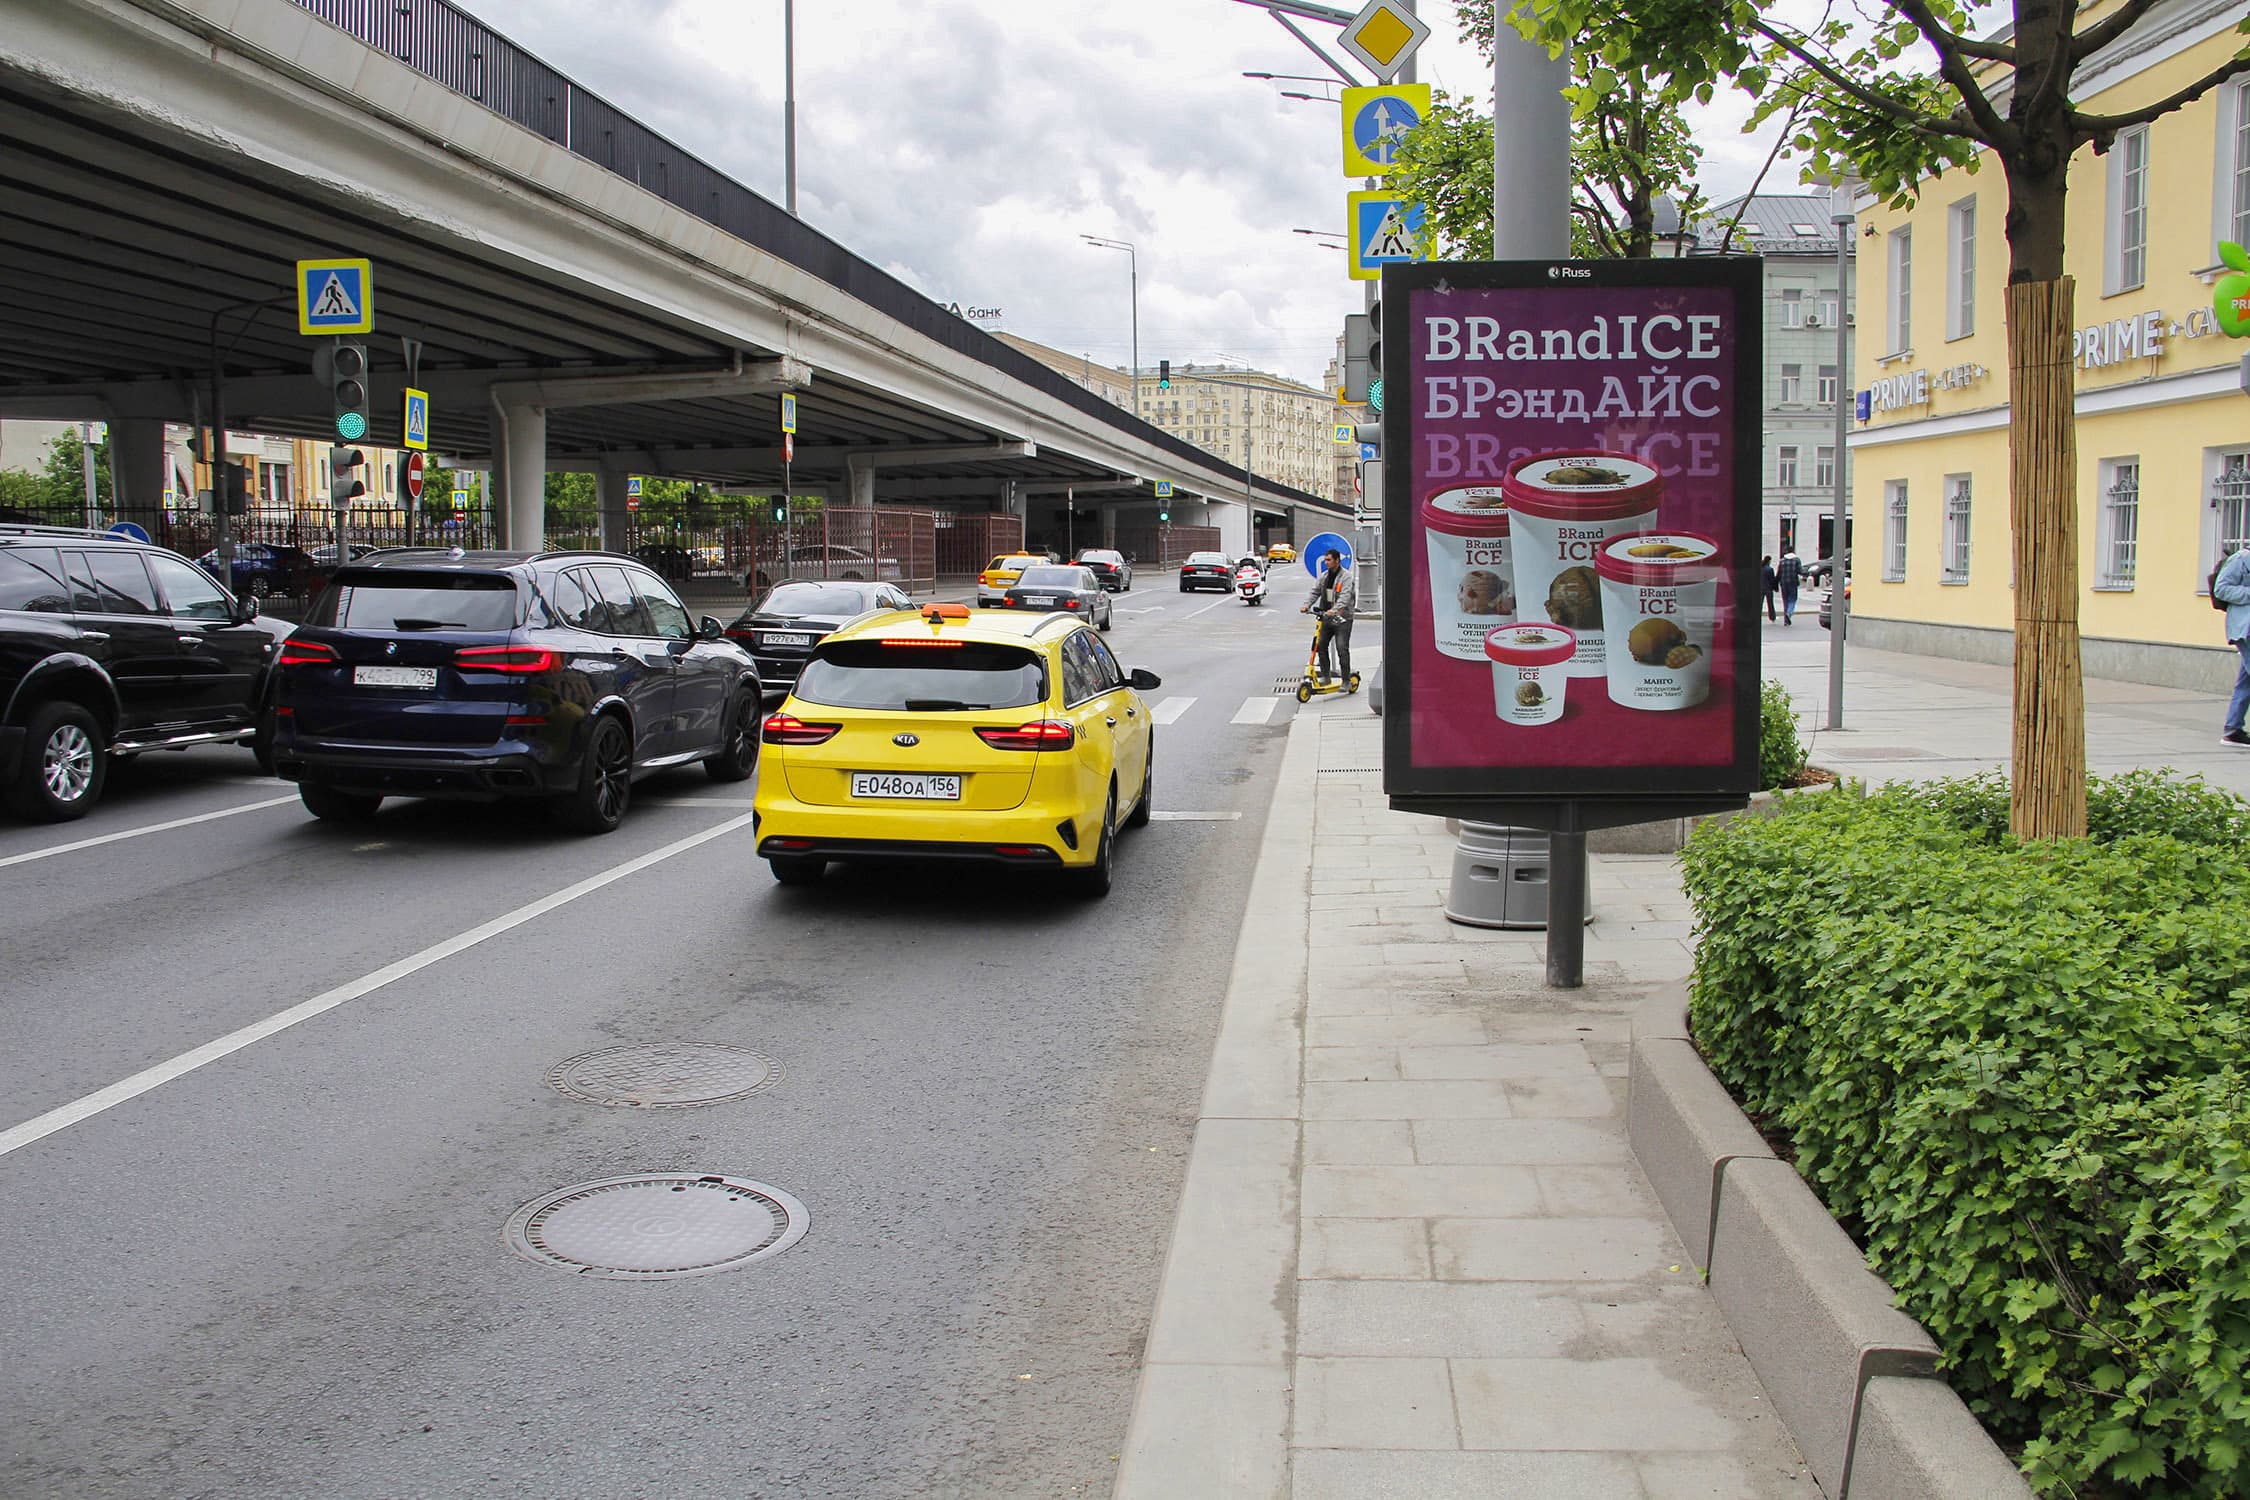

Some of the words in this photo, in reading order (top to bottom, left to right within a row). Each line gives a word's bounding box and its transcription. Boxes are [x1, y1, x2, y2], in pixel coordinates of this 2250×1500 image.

[1562, 266, 1592, 278] Russ
[967, 306, 1002, 319] банк
[1424, 314, 1721, 361] BRandICE
[1424, 365, 1721, 424] БРэндАЙС
[1871, 368, 1929, 413] PRIME
[1558, 527, 1605, 539] BRand
[1465, 539, 1502, 549] BRand
[1465, 549, 1503, 565] ICE
[1639, 587, 1677, 598] BRand
[1639, 598, 1678, 615] ICE
[1518, 672, 1541, 681] ICE
[896, 734, 916, 744] KIA
[929, 777, 955, 791] 156
